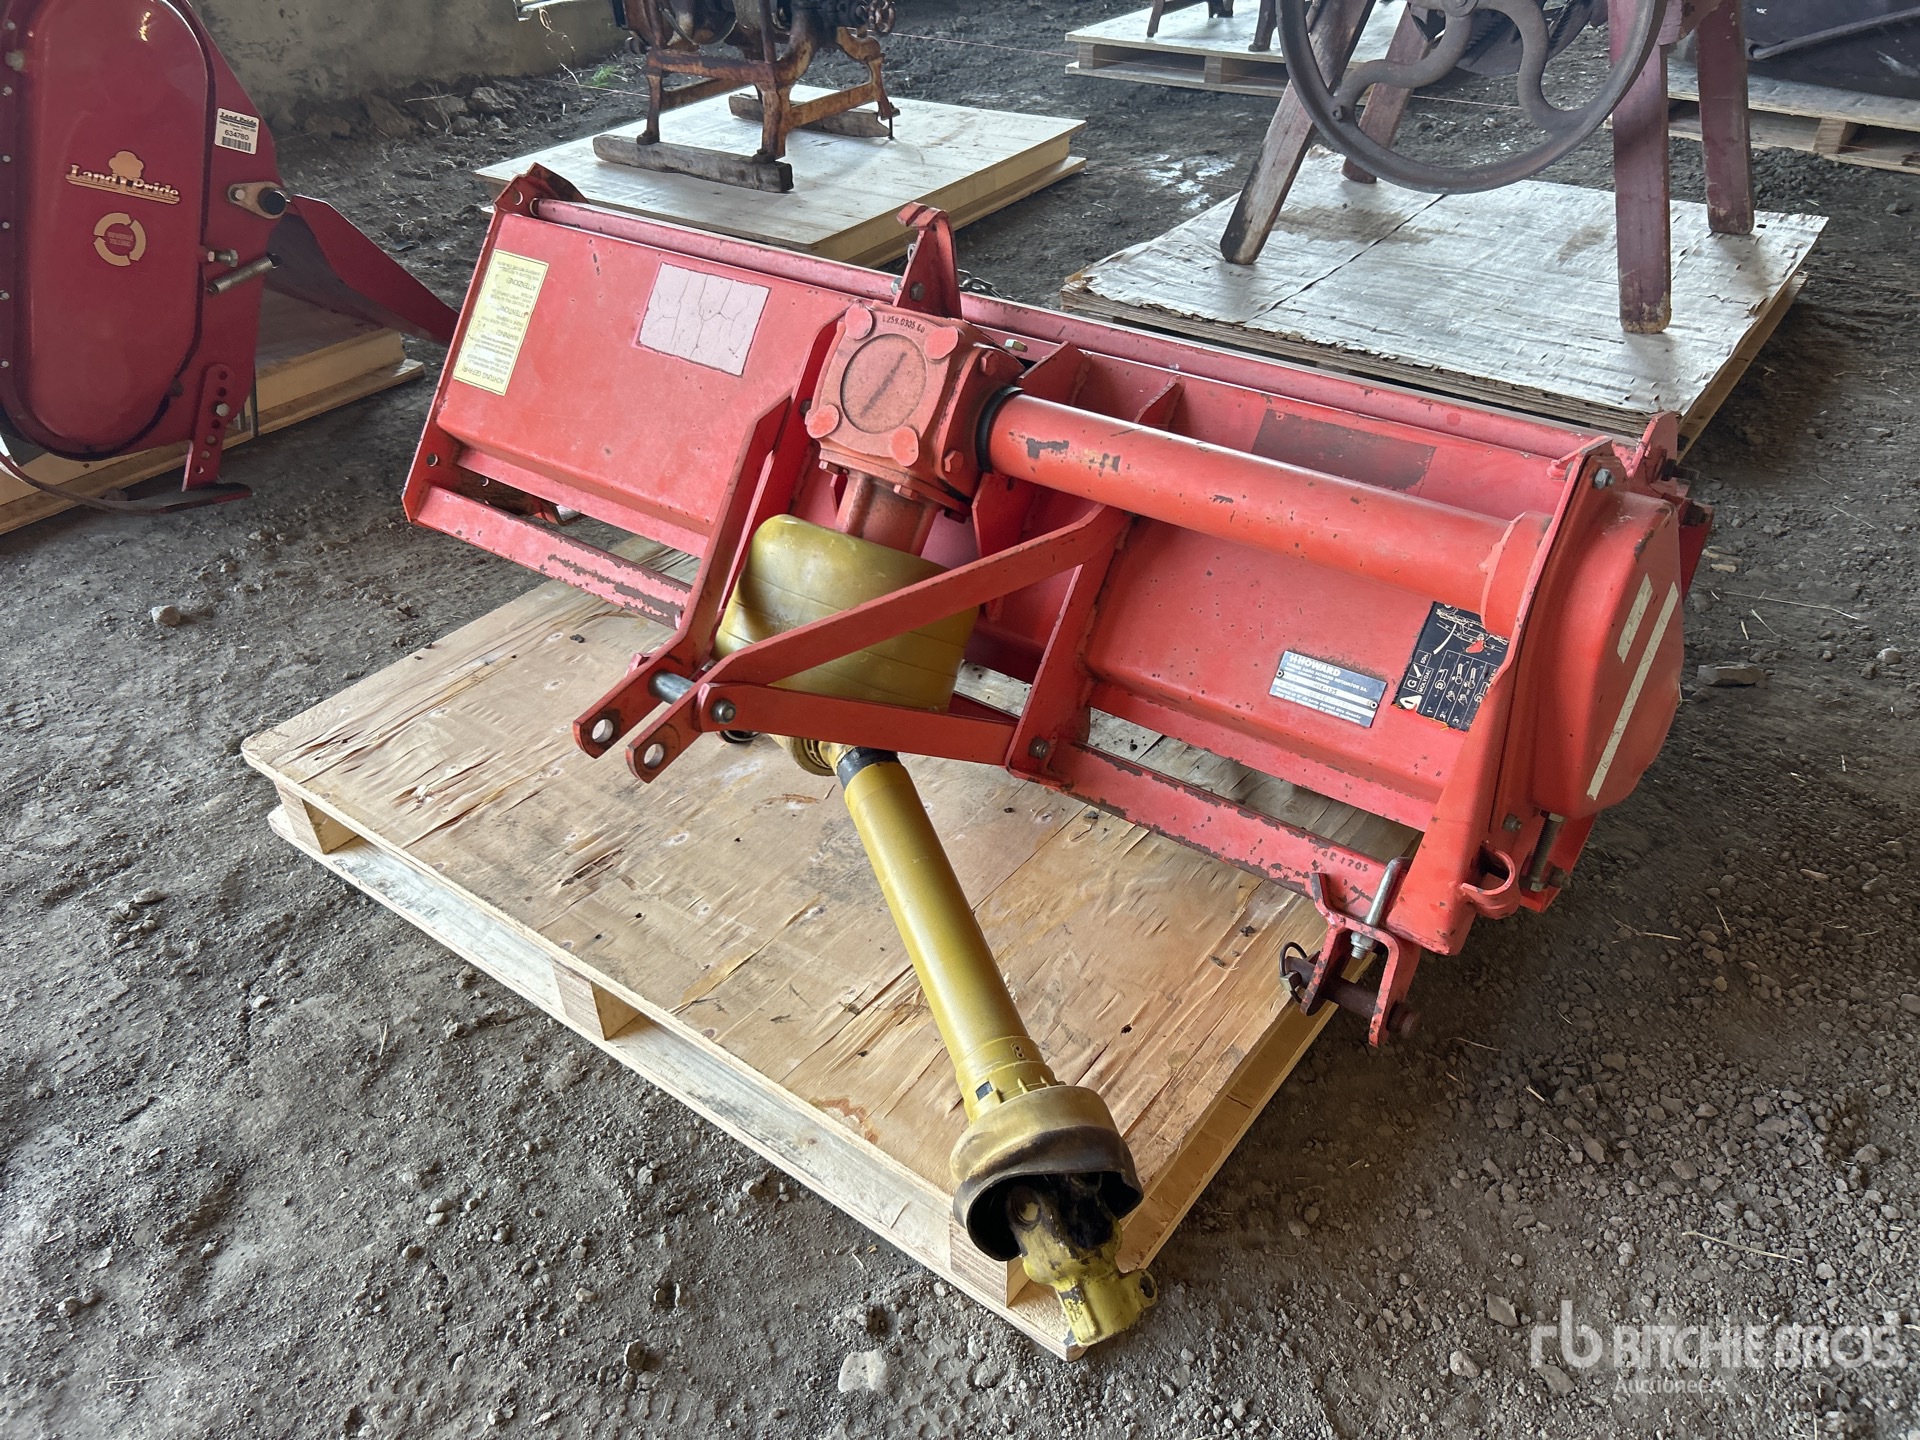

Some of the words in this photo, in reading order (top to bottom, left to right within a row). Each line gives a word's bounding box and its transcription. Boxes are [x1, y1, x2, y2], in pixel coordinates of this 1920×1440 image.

[224, 129, 250, 141] 634780
[69, 163, 118, 187] Land
[131, 177, 180, 198] Pride
[1297, 656, 1342, 677] HOWARD
[1407, 679, 1418, 688] G
